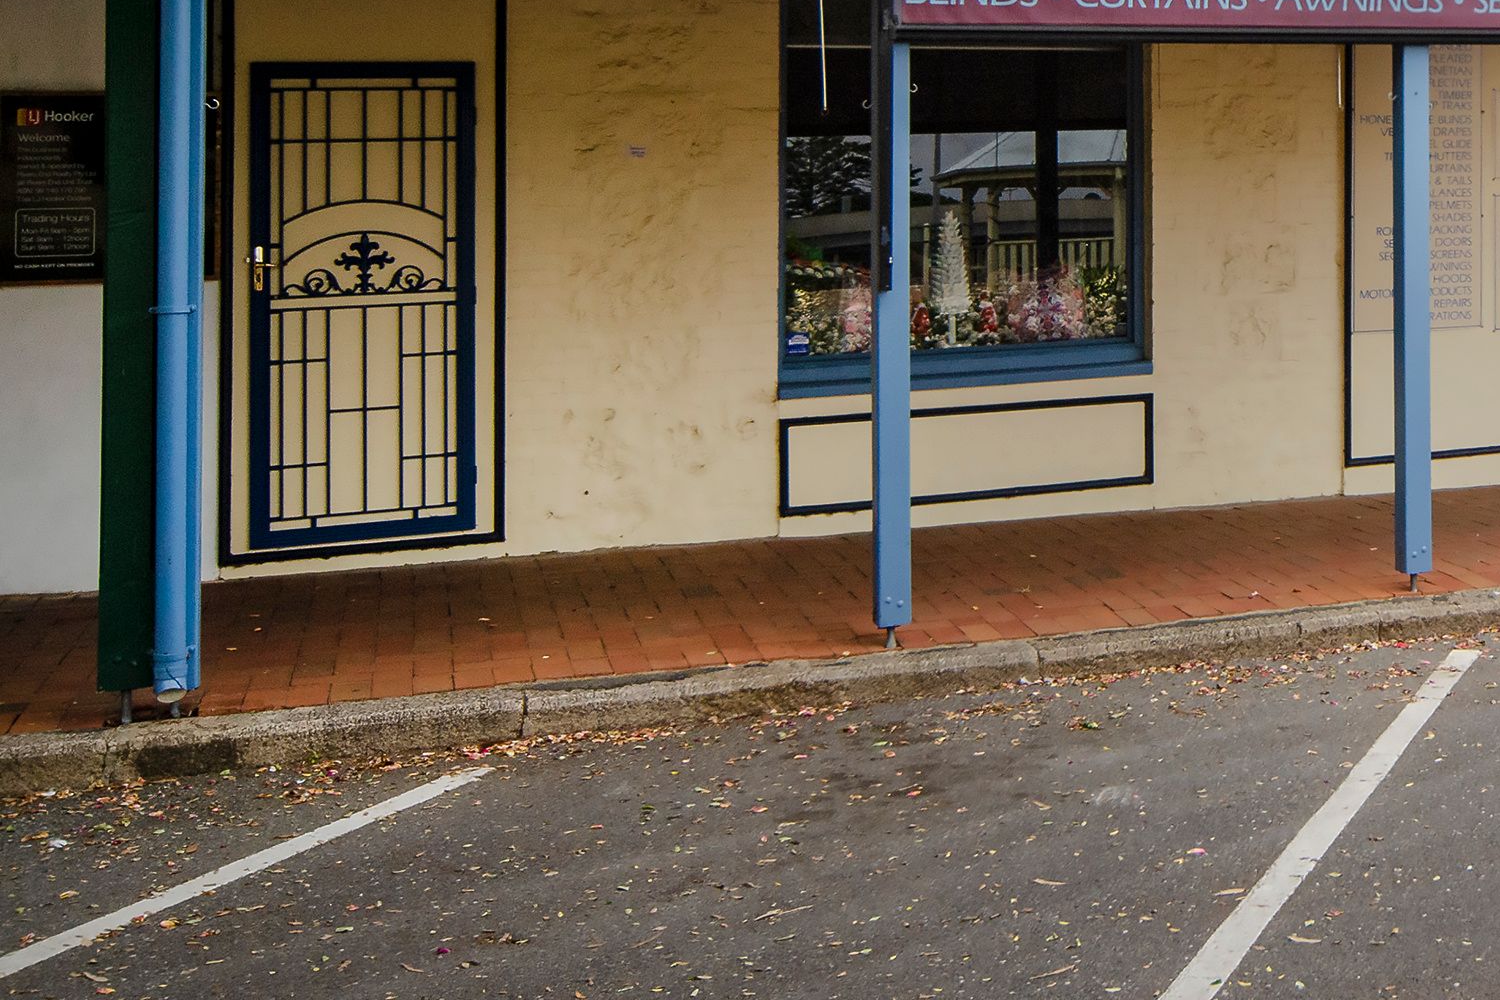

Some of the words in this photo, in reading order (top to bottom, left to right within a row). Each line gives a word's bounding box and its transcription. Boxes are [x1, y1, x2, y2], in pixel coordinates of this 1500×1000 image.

[1439, 91, 1472, 100] TIMBER
[28, 110, 40, 125] LJ
[44, 110, 94, 121] Hooker
[1438, 114, 1472, 124] BLINDS
[1433, 127, 1472, 136] DRAPES
[17, 133, 71, 143] Welcome
[1442, 140, 1472, 149] GLIDE
[1429, 152, 1472, 161] HUTTERS
[1447, 176, 1472, 185] TAILS
[22, 214, 58, 224] Trading
[60, 213, 90, 222] Hours
[1433, 213, 1472, 222] SHADES
[1435, 238, 1472, 247] DOORS
[1431, 250, 1472, 260] SCREENS
[1433, 275, 1472, 284] HOODS
[1434, 299, 1472, 309] REPAIRS
